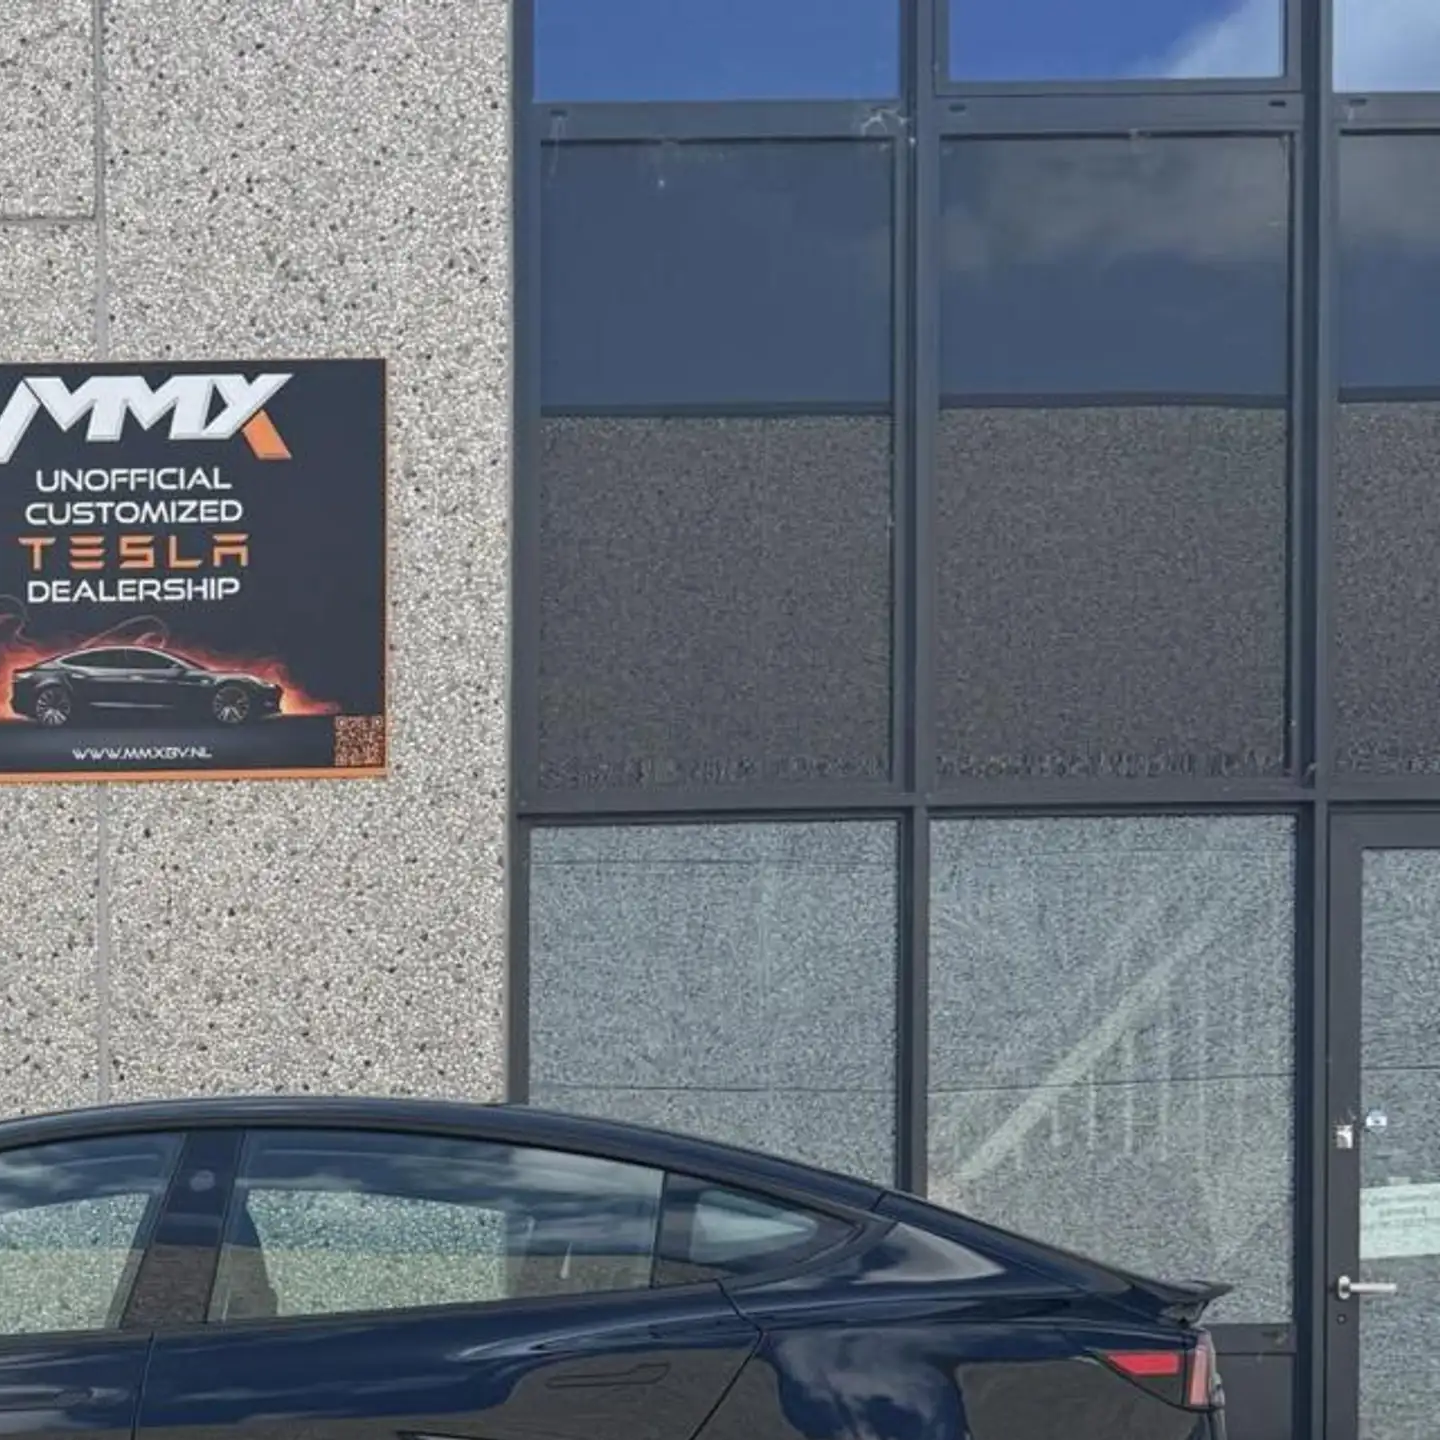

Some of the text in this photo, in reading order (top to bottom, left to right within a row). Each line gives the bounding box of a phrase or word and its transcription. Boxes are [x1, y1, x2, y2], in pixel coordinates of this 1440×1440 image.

[35, 467, 232, 493] UNOFFICIAL
[24, 499, 243, 526] CUSTOMIZED
[18, 533, 250, 571] TESLA
[27, 577, 241, 604] DEALERSHIP
